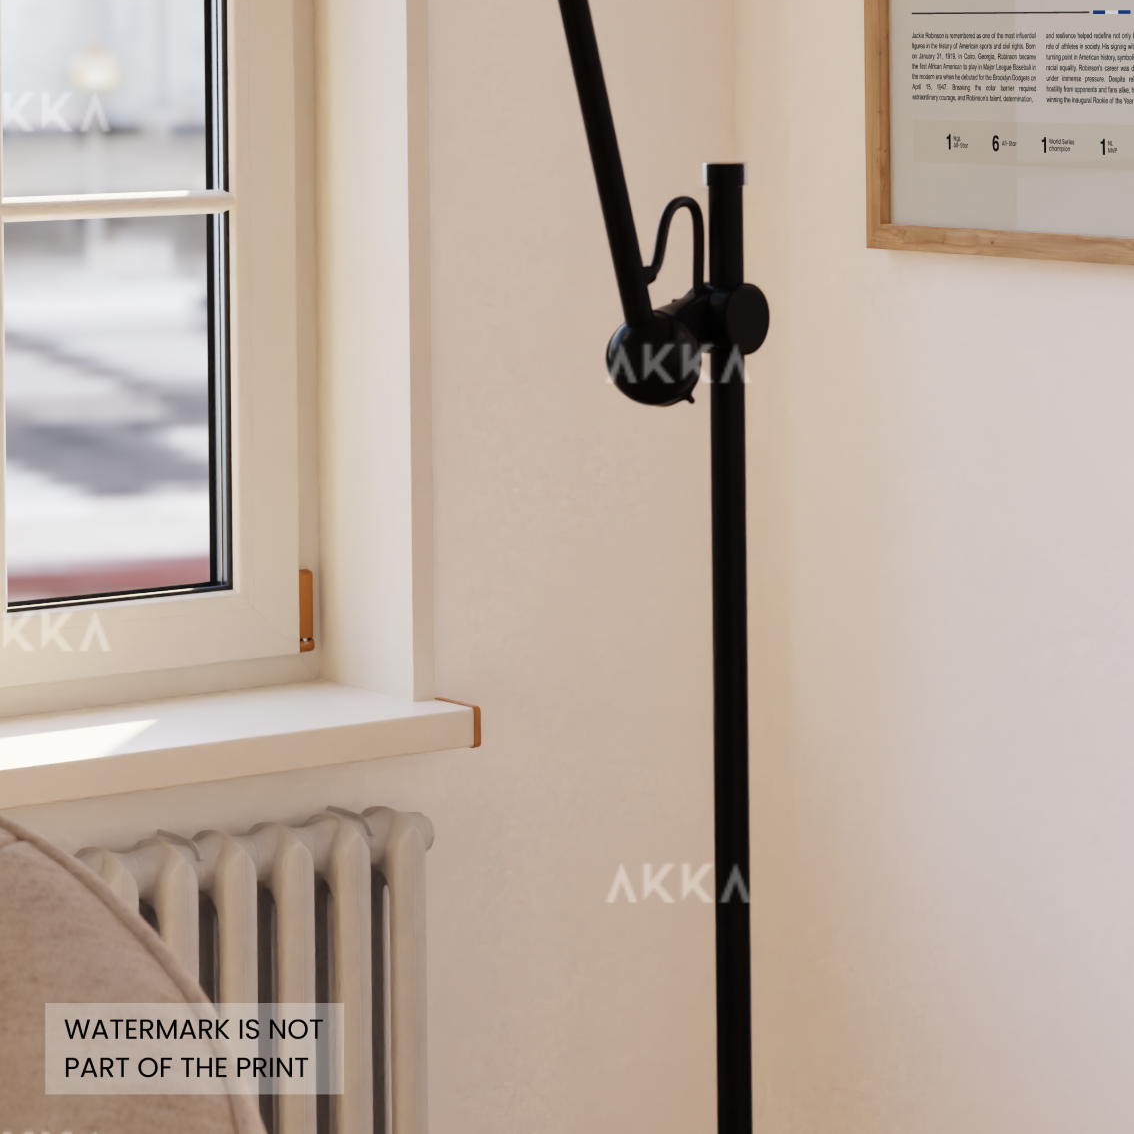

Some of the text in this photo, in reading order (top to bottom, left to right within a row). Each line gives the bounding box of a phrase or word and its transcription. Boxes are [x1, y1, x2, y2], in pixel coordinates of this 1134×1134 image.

[946, 133, 951, 150] 1
[992, 134, 1000, 152] 6
[1041, 136, 1047, 154] 1
[1100, 138, 1106, 156] 1
